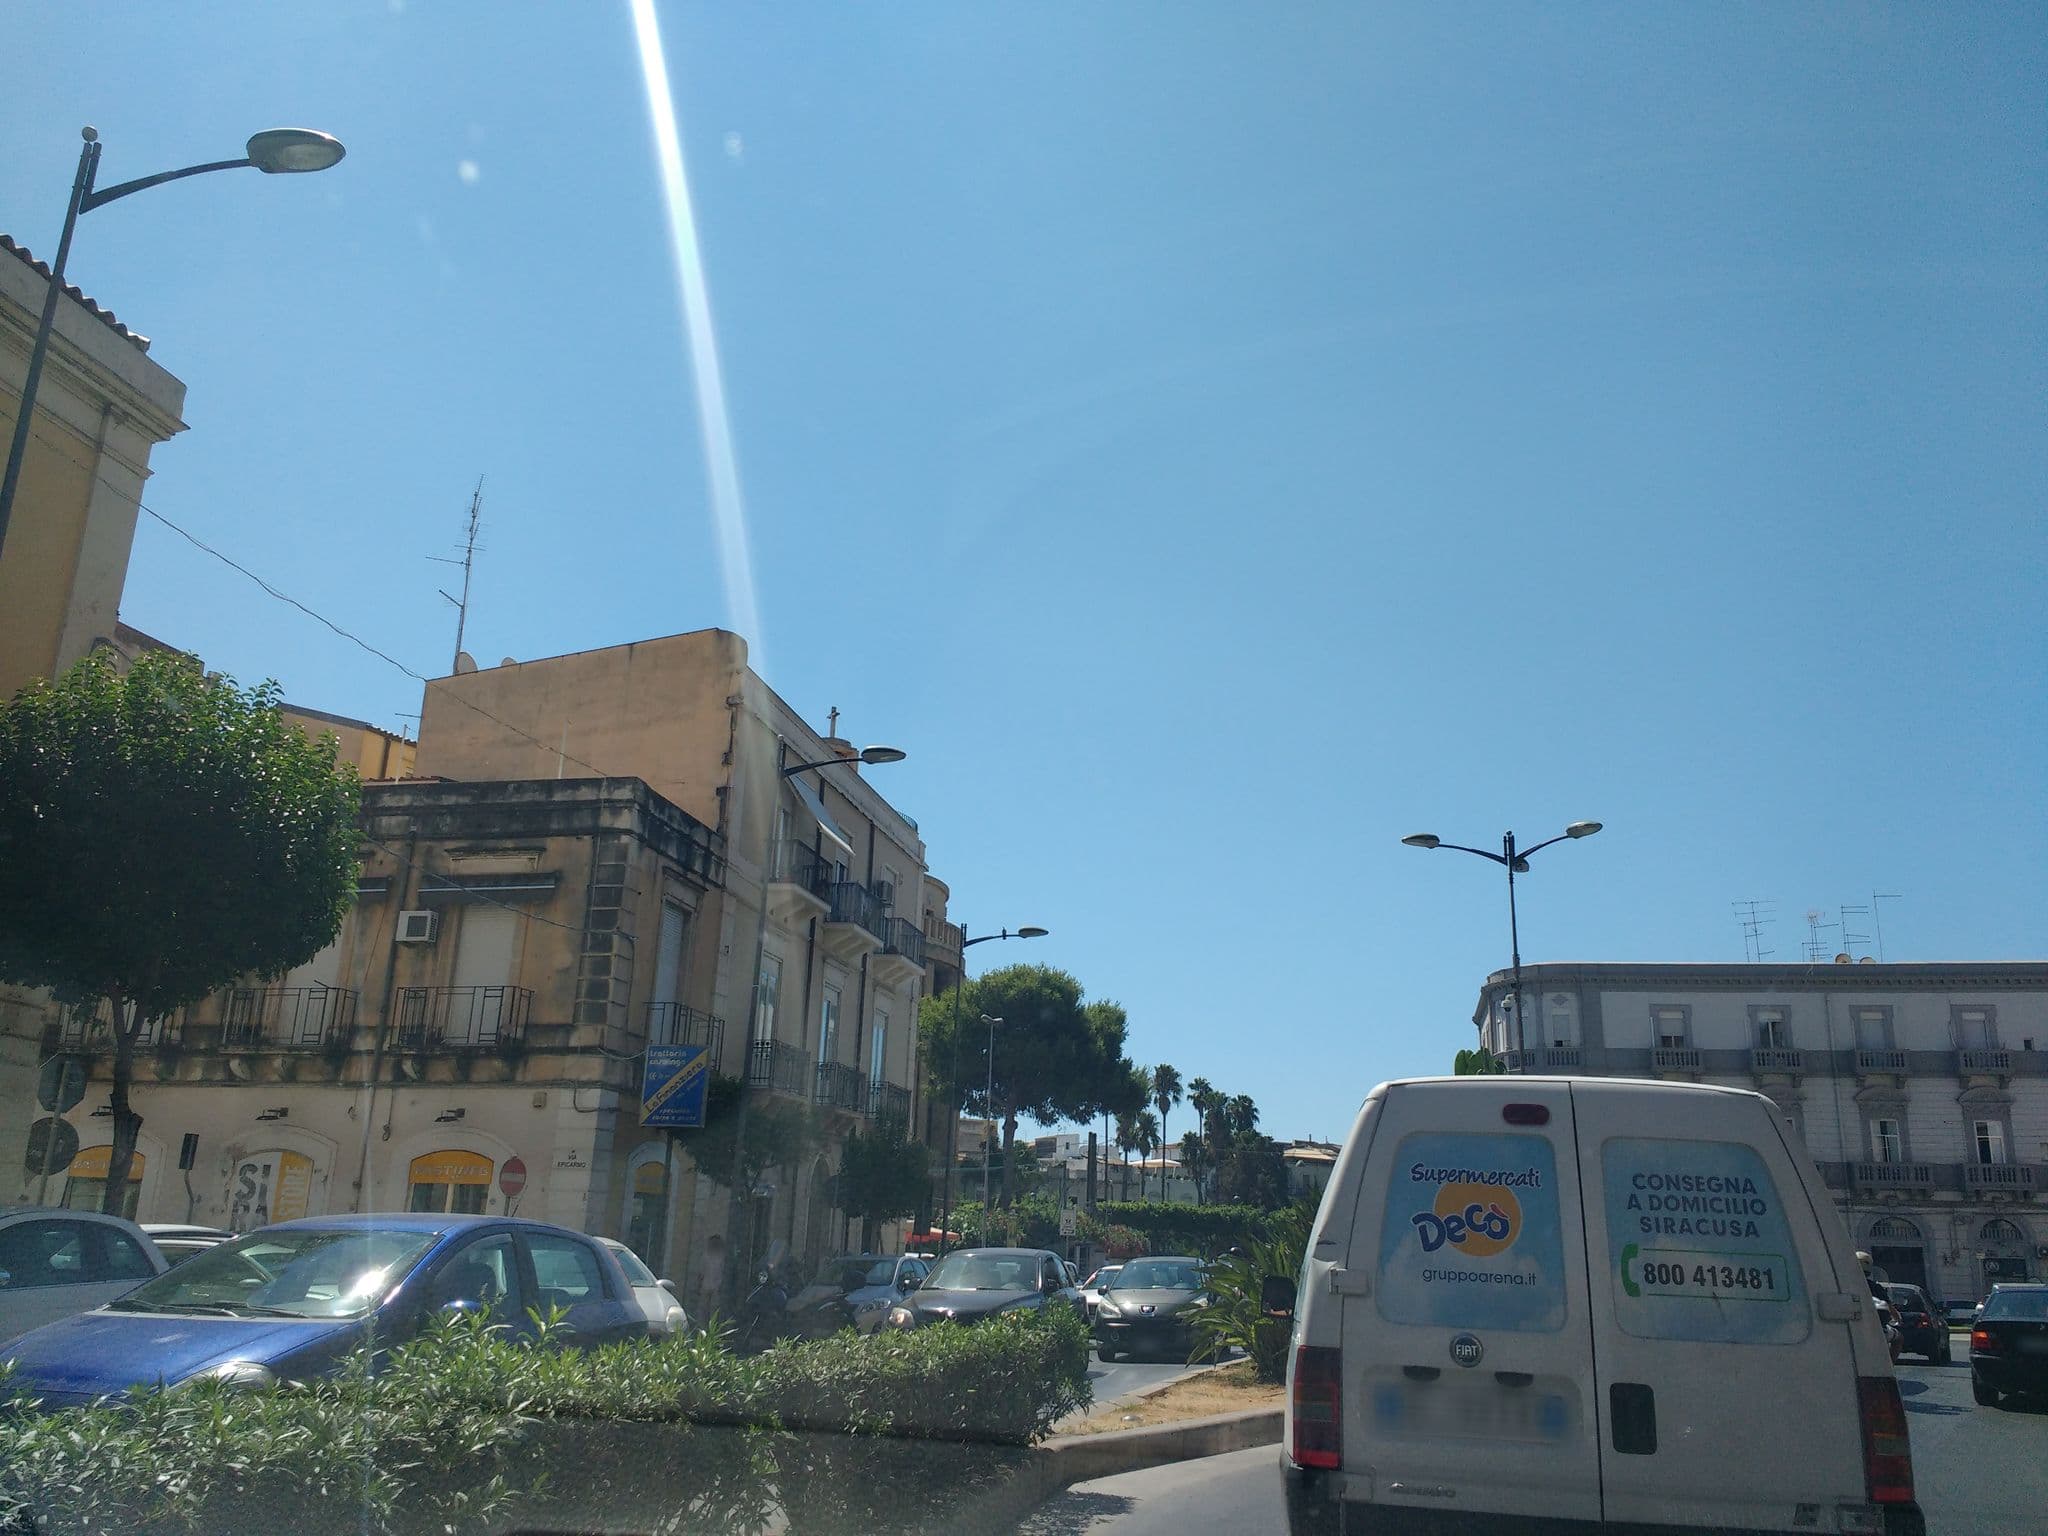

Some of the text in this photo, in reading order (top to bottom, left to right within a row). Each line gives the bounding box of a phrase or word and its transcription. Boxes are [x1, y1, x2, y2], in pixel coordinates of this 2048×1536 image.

[1410, 1162, 1541, 1188] Supermercati
[1632, 1173, 1758, 1195] CONSEGNA
[1627, 1193, 1767, 1216] A DOMICILIO
[1639, 1217, 1761, 1239] SIRACUSA
[1422, 1269, 1537, 1287] gruppoarena.it
[1643, 1262, 1775, 1290] 800 413481
[1455, 1344, 1478, 1356] FIAT
